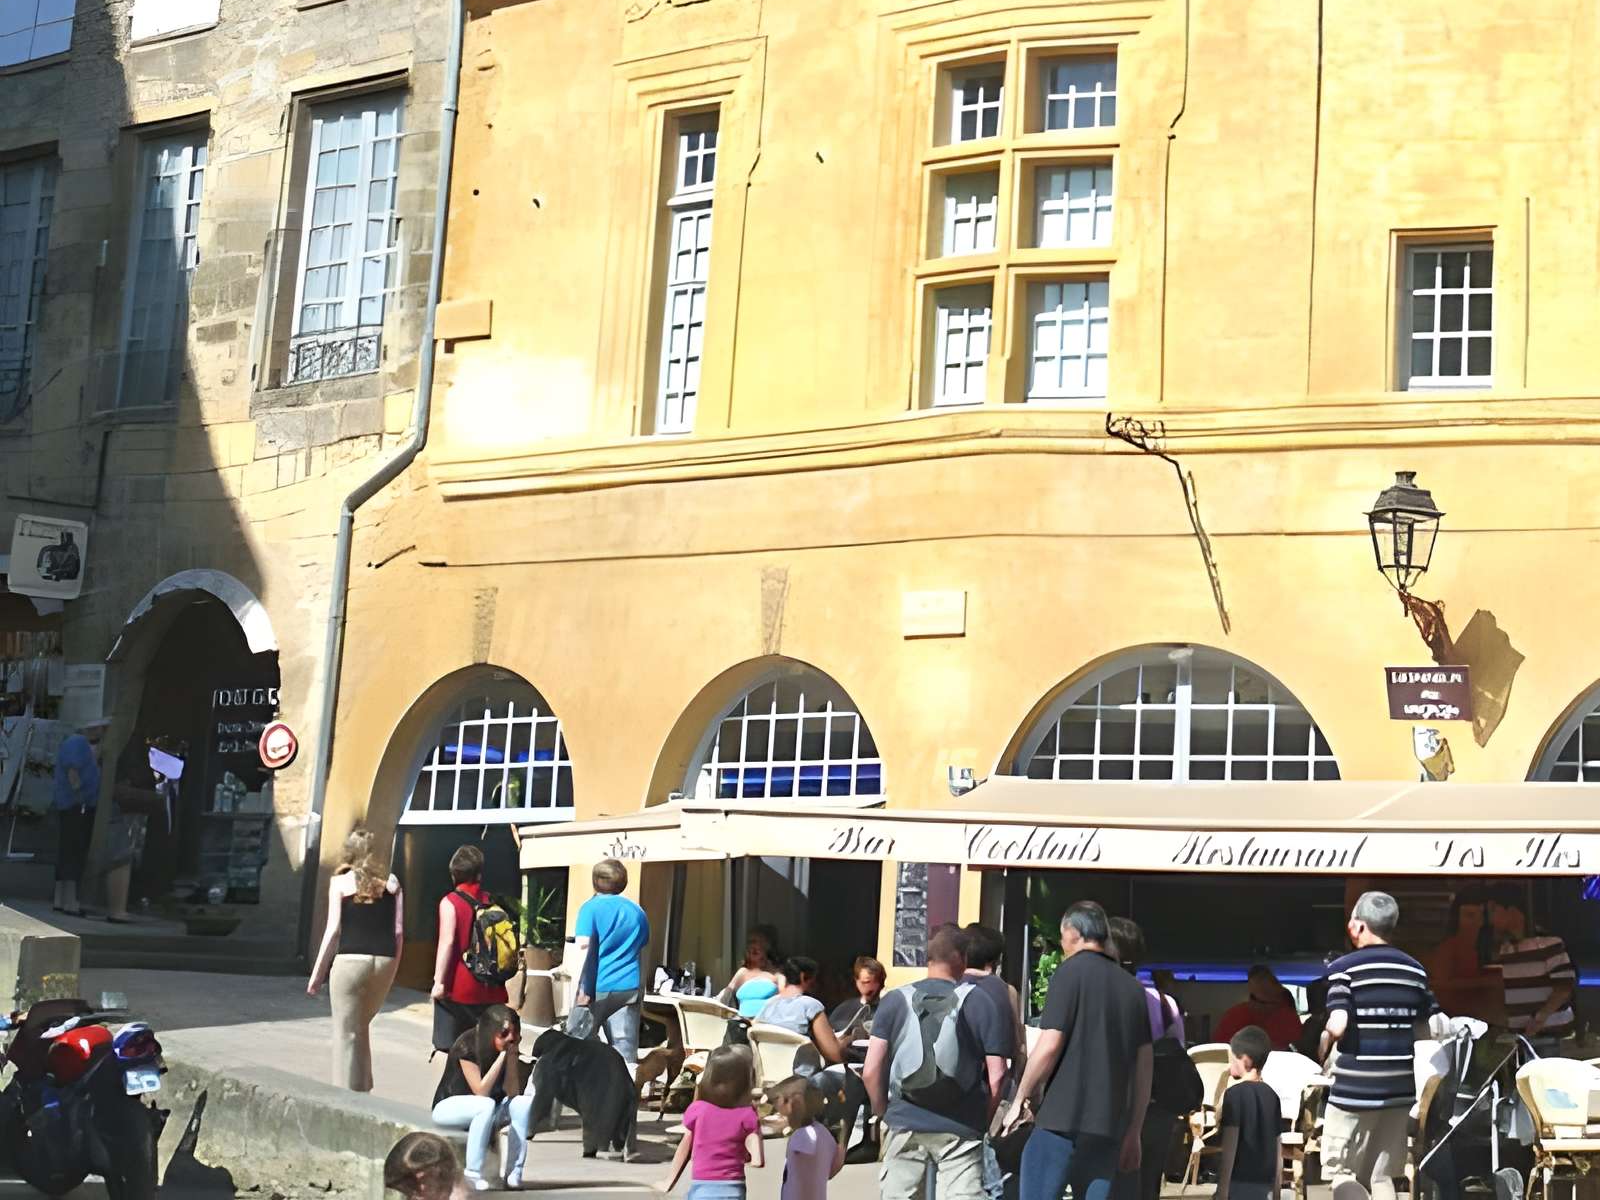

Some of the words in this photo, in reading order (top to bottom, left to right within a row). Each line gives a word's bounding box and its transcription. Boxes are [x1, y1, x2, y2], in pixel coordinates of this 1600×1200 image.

[827, 825, 896, 855] Bar
[964, 823, 1102, 862] Cocktails
[1171, 831, 1369, 868] Restaurant
